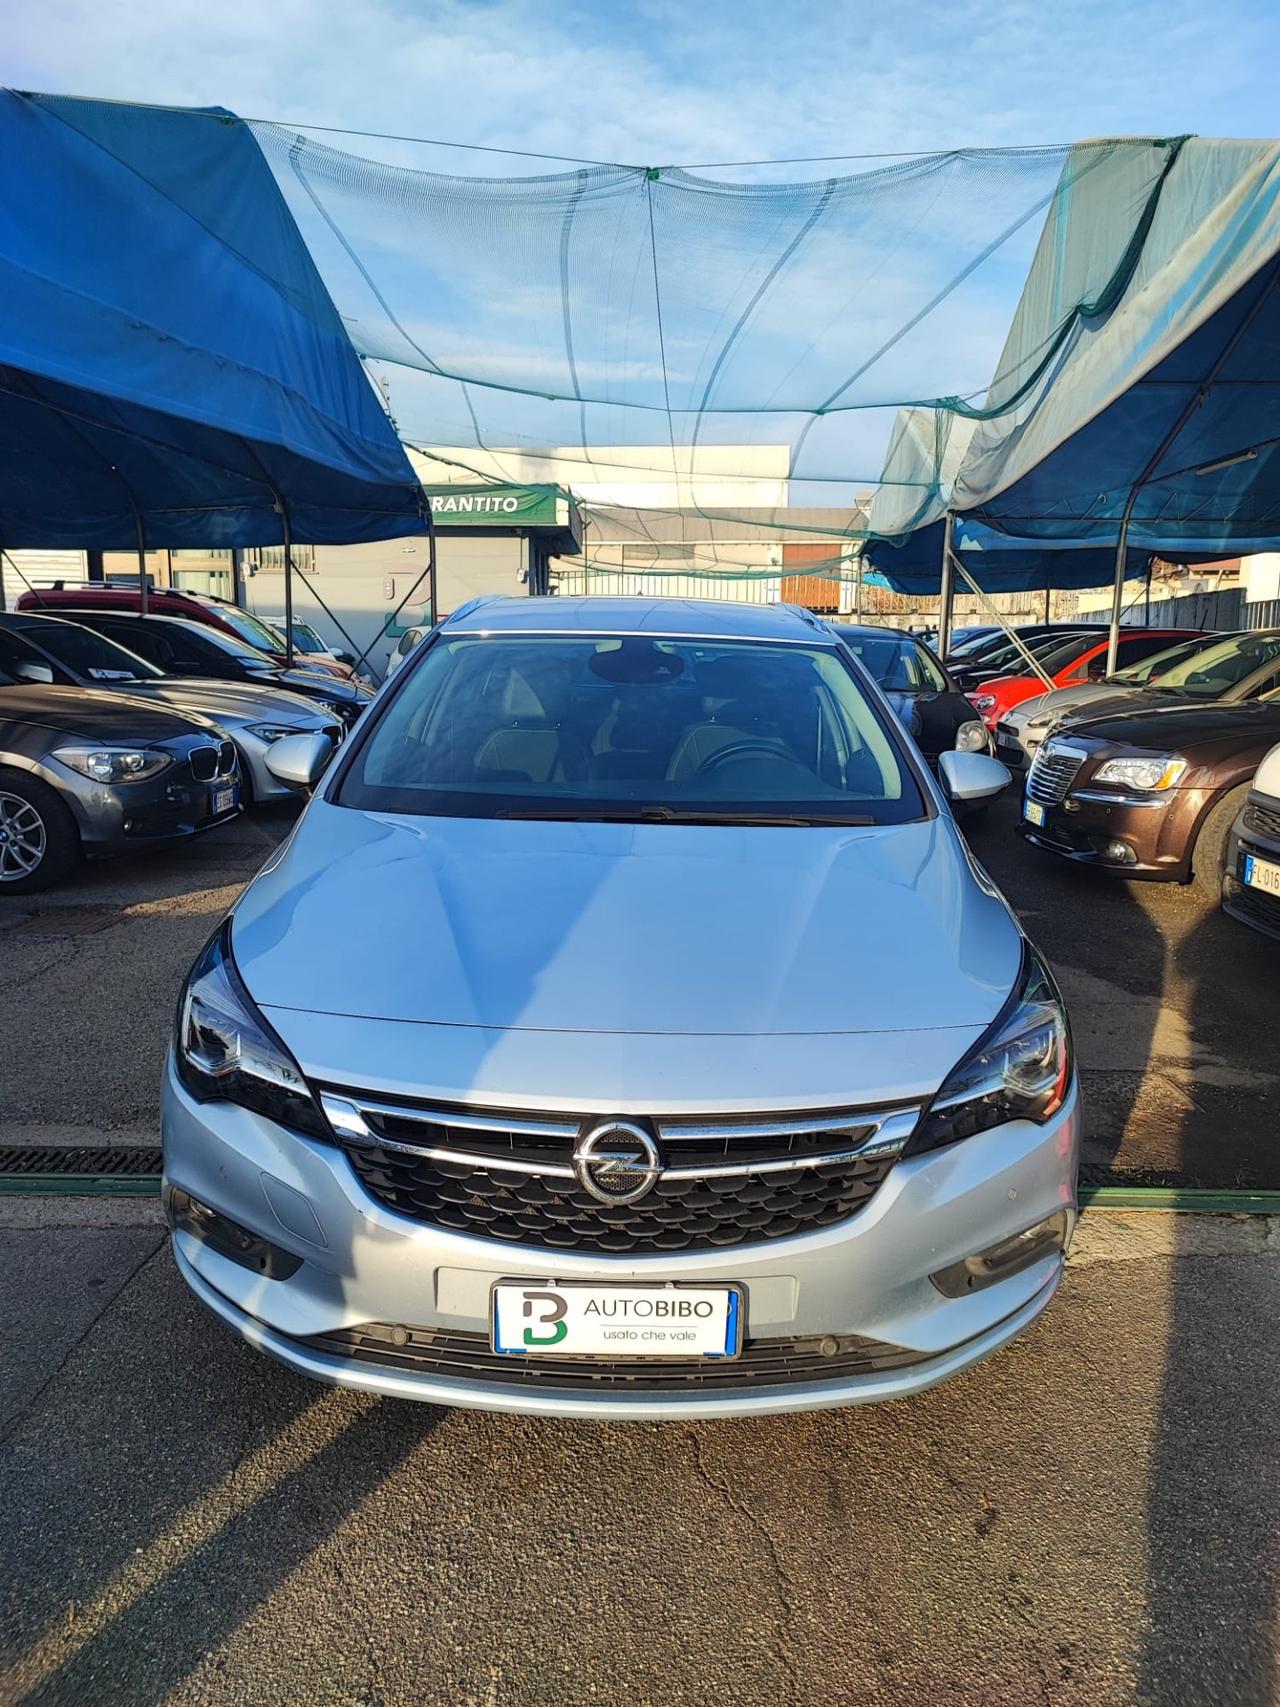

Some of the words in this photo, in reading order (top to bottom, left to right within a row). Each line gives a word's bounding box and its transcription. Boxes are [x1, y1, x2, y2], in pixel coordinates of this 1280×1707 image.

[583, 1298, 713, 1319] AUTOBIBO
[603, 1329, 638, 1341] usato
[641, 1329, 666, 1341] che
[669, 1329, 697, 1341] vale
